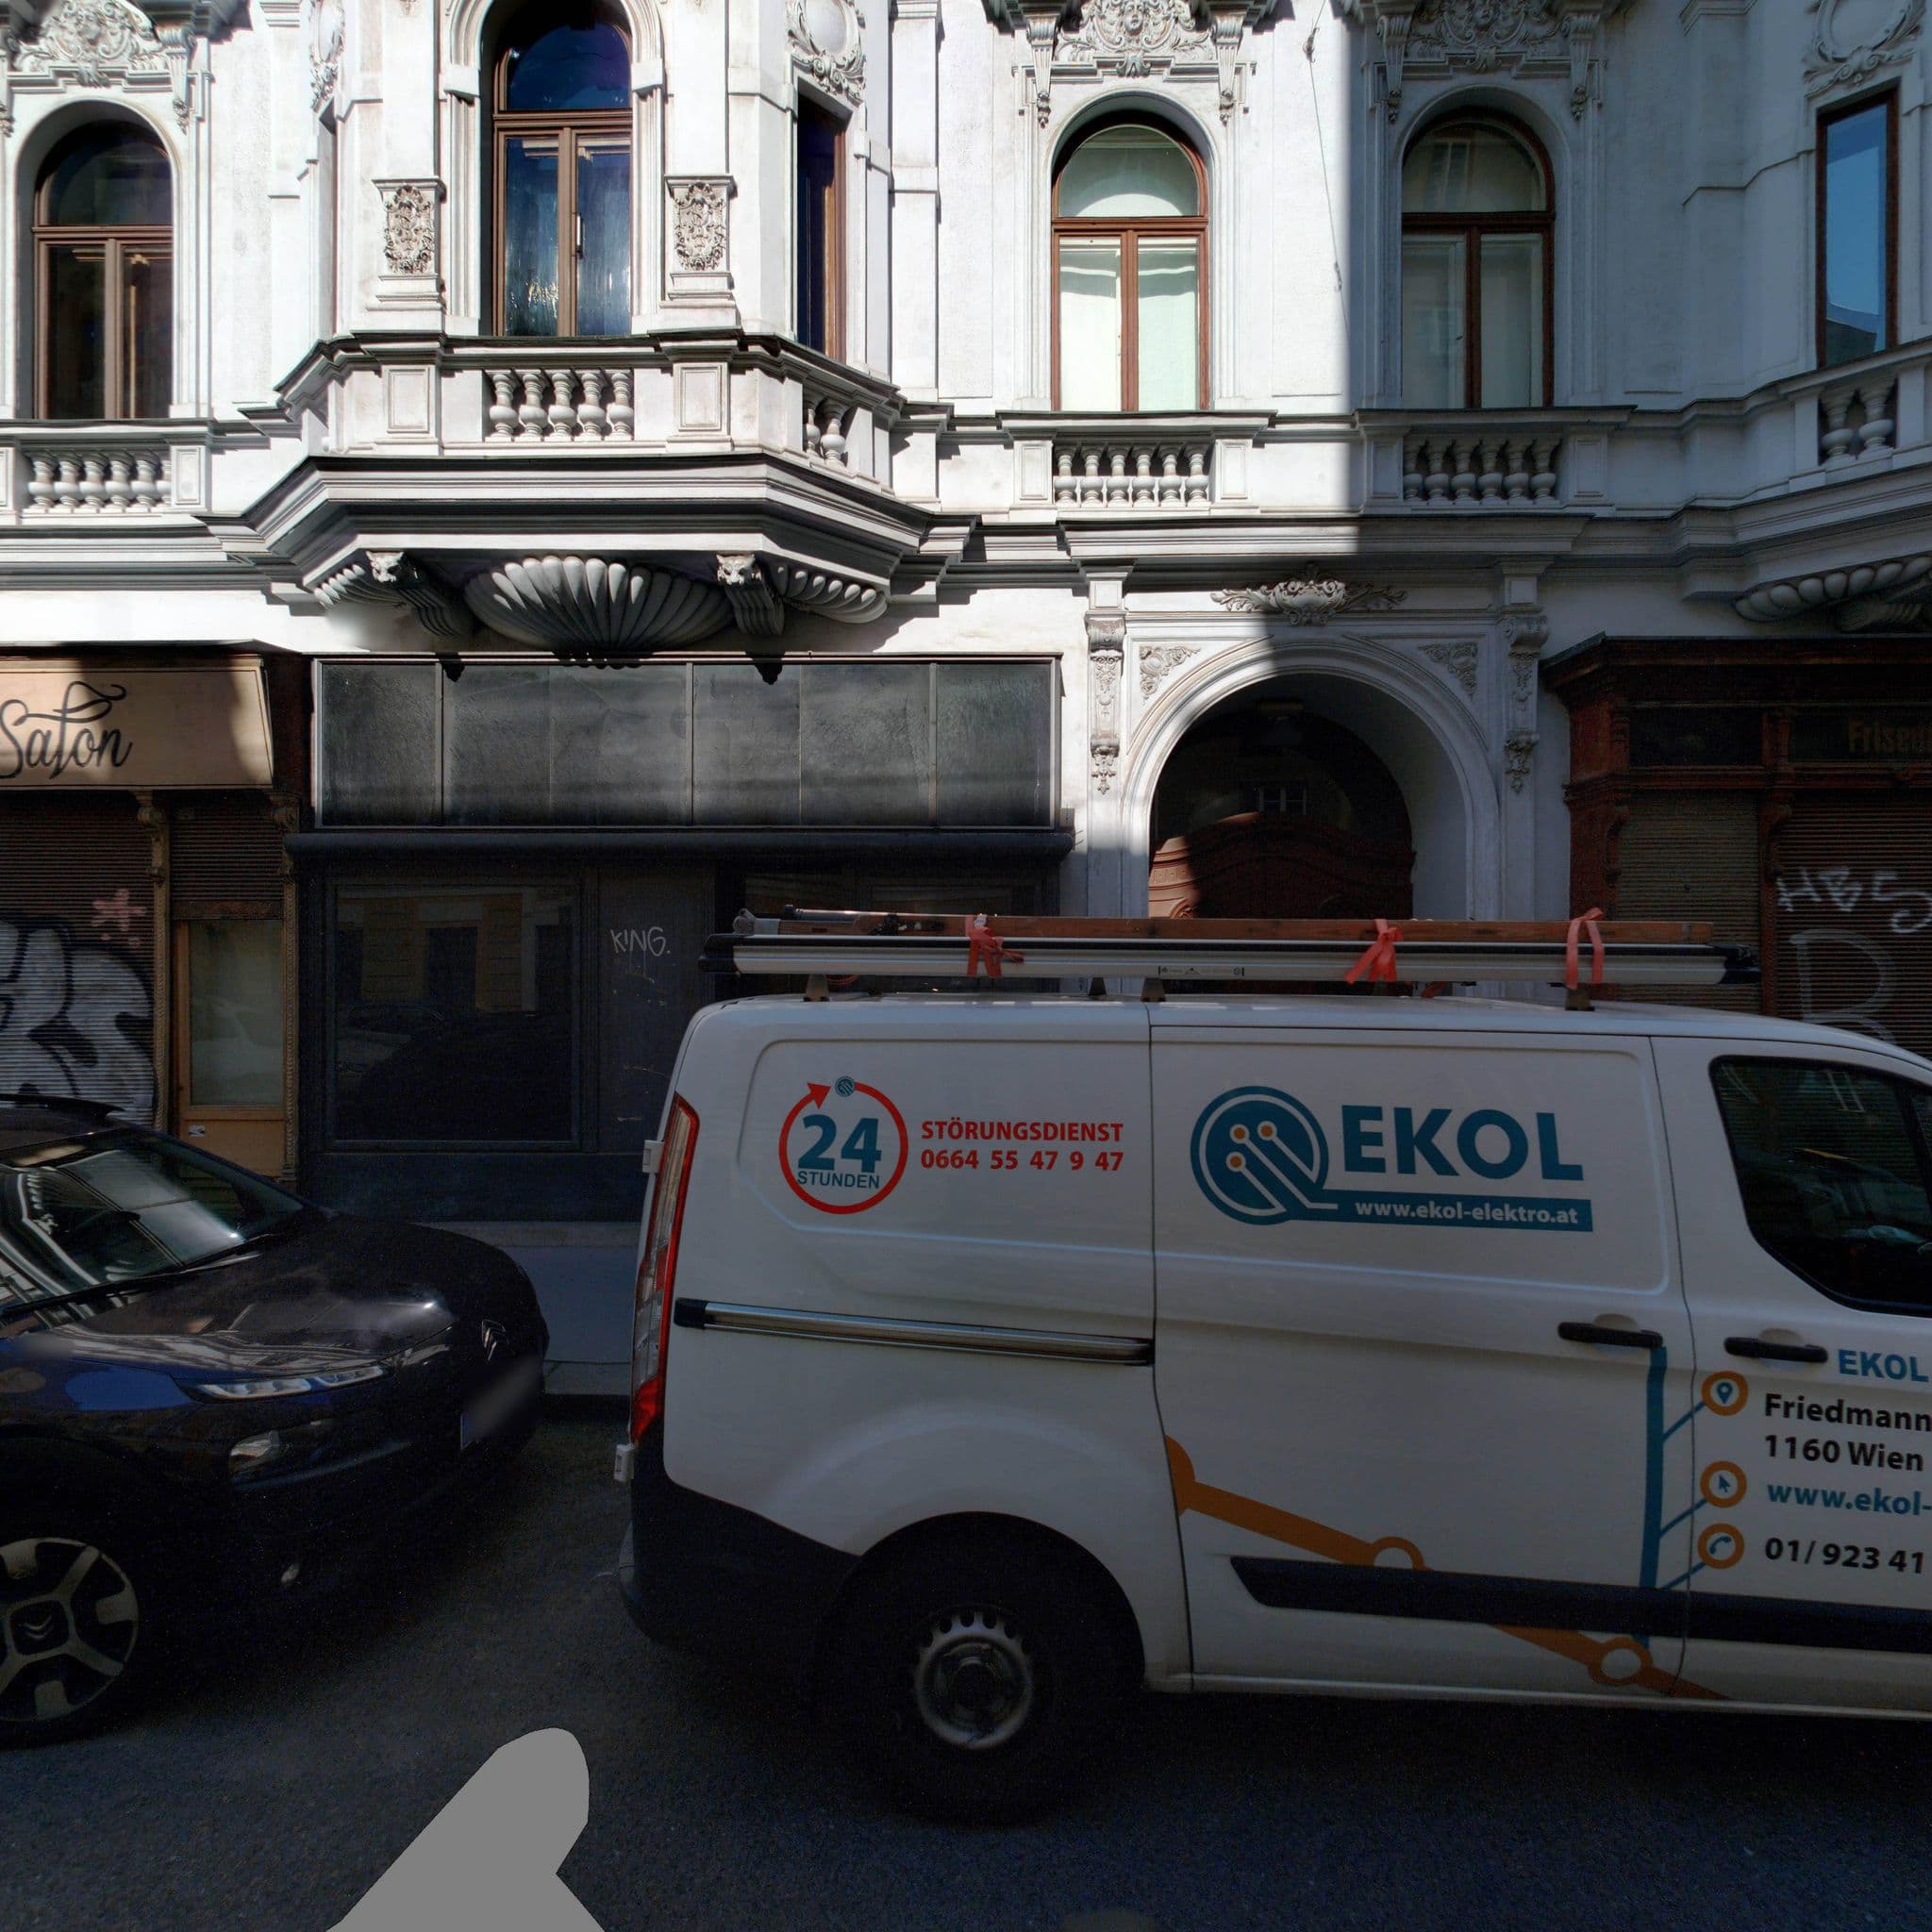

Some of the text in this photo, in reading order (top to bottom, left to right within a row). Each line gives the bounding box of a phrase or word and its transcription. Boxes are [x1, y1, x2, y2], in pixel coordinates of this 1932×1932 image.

[0, 681, 133, 779] Salon
[798, 1114, 882, 1173] 24
[922, 1117, 1124, 1141] STÖRUNGSDIENST
[1341, 1105, 1584, 1181] EKOL
[921, 1149, 1124, 1171] 0664 55 47 9 47
[798, 1171, 879, 1189] STUNDEN
[1355, 1200, 1578, 1224] www.ekol-elektro.at
[1839, 1349, 1928, 1382] EKOL
[1766, 1435, 1924, 1472] 1160 Wien
[1767, 1484, 1932, 1515] www.ekol-
[1889, 1550, 1924, 1574] 41
